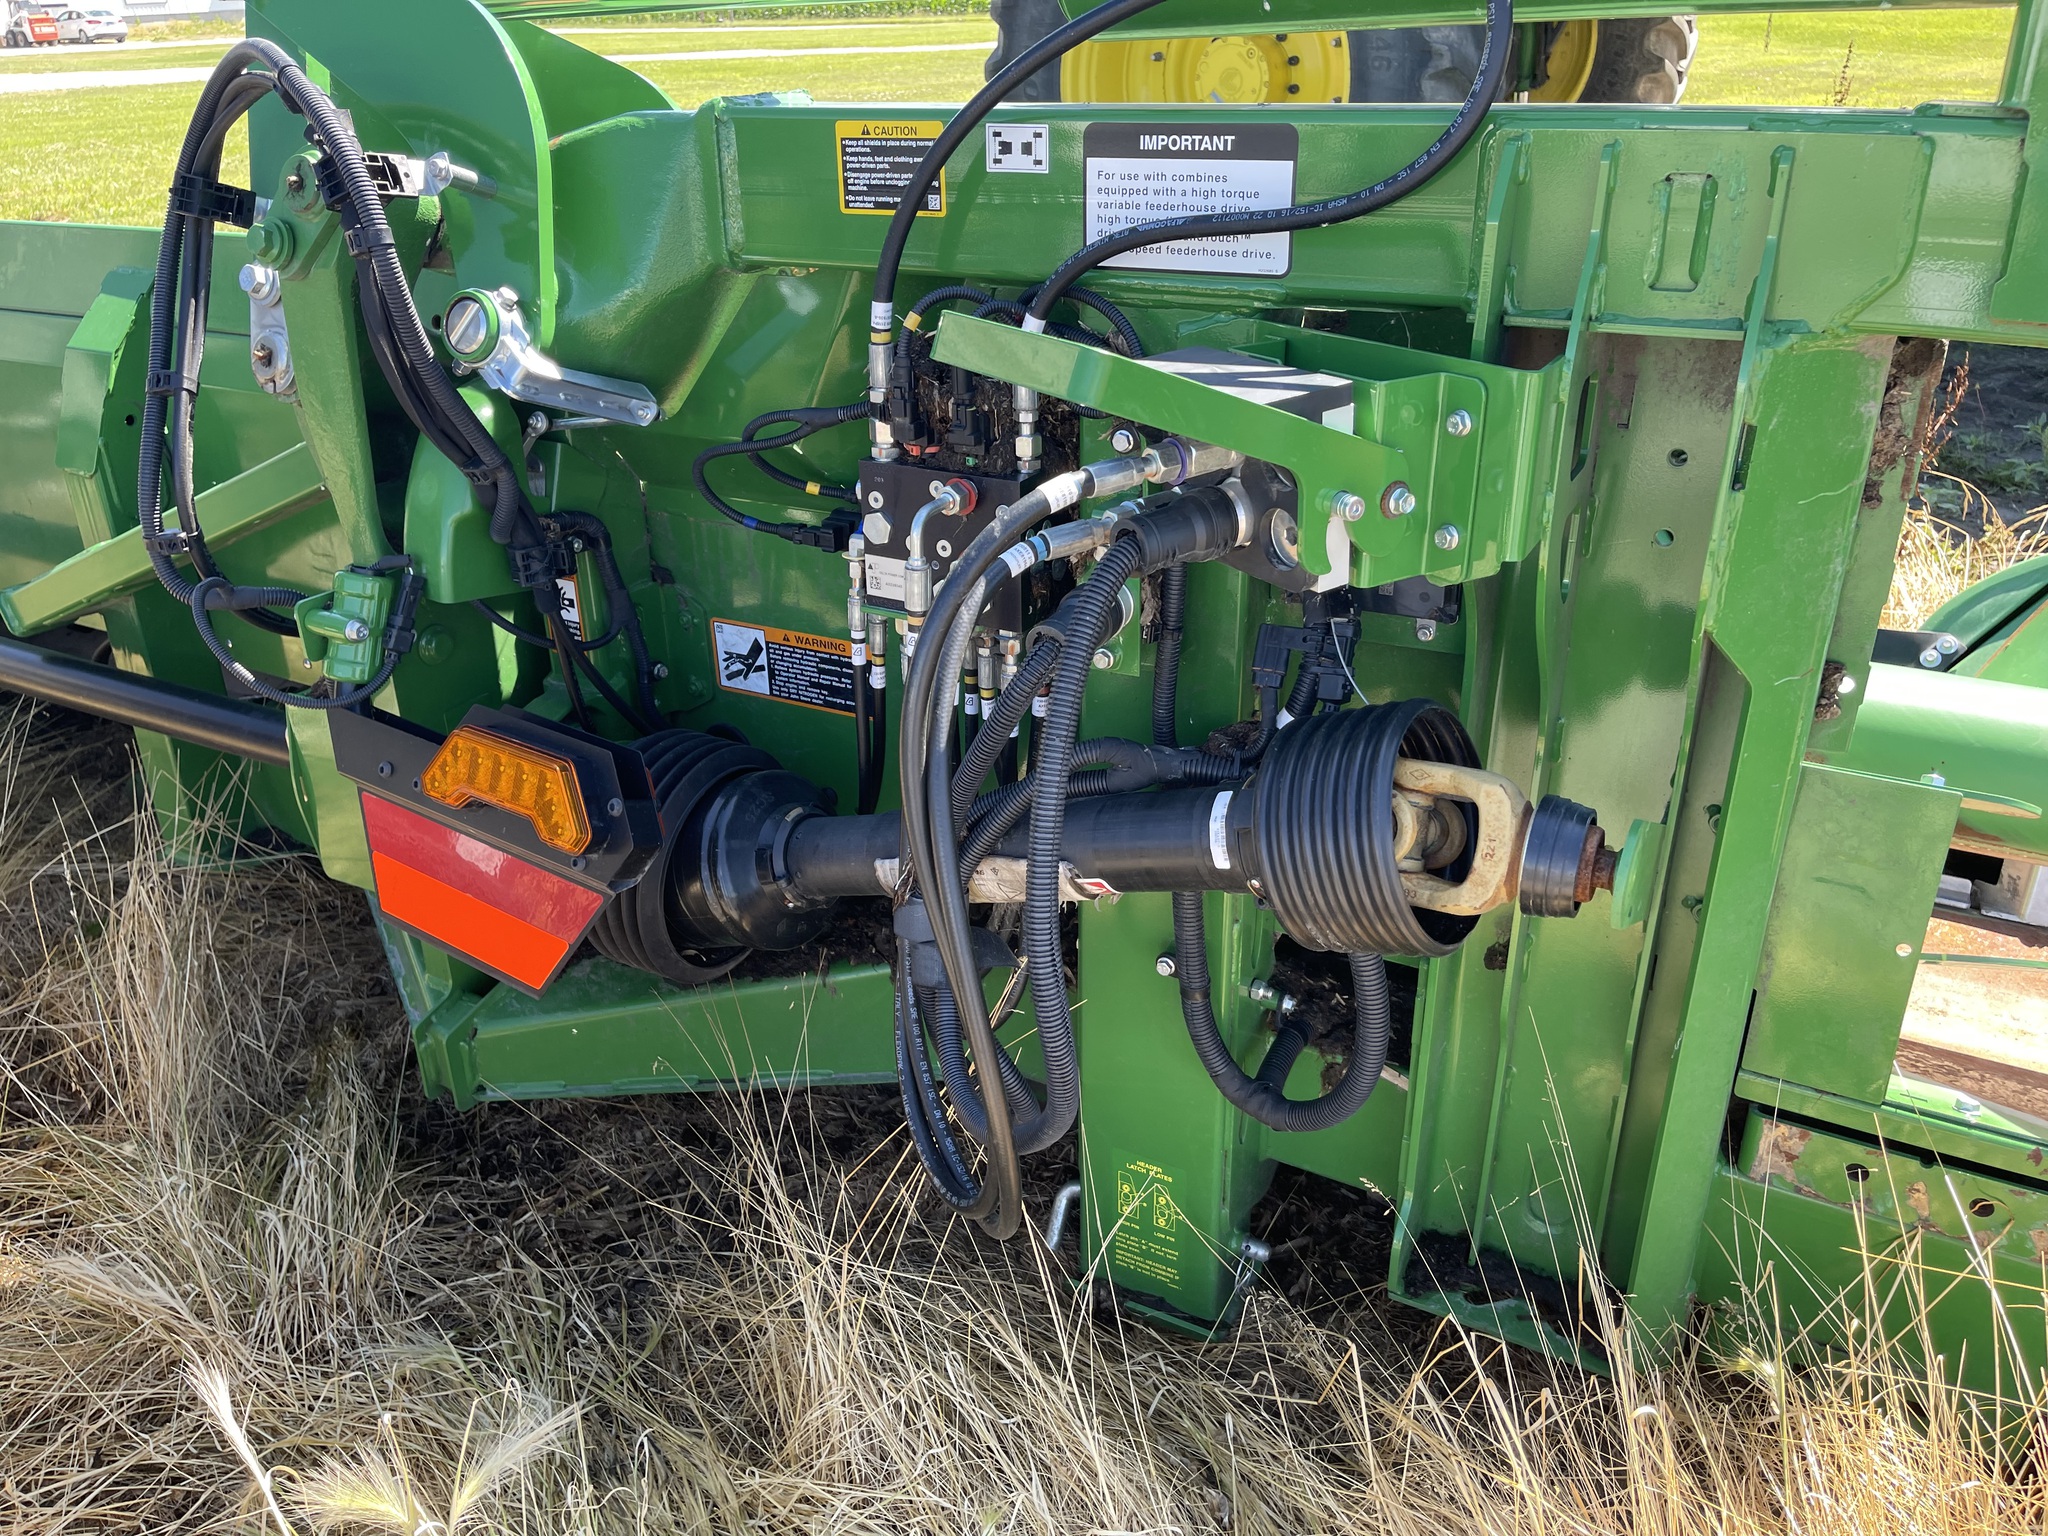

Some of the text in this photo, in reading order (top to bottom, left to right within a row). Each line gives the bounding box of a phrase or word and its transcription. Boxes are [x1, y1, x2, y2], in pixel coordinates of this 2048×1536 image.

[1463, 98, 1474, 113] 100
[873, 126, 918, 136] CAUTION
[1139, 134, 1236, 151] IMPORTANT
[894, 156, 913, 164] clothing
[1097, 170, 1228, 183] For use with combines
[1097, 186, 1260, 201] equipped with a high torque
[1373, 184, 1385, 193] DN
[1097, 200, 1141, 210] variable
[1145, 201, 1217, 213] feederhouse
[1097, 213, 1121, 226] high
[1253, 211, 1263, 219] 22
[1166, 245, 1238, 258] feederhouse
[1242, 249, 1276, 260] drive.
[794, 635, 847, 653] WARNING
[907, 976, 915, 1005] exceeds
[912, 1023, 921, 1036] 100
[915, 1037, 924, 1051] R17
[920, 1061, 929, 1071] EN
[922, 1072, 933, 1085] 857
[1126, 1162, 1173, 1183] LATCH PLATES
[1136, 1160, 1163, 1174] HEADER
